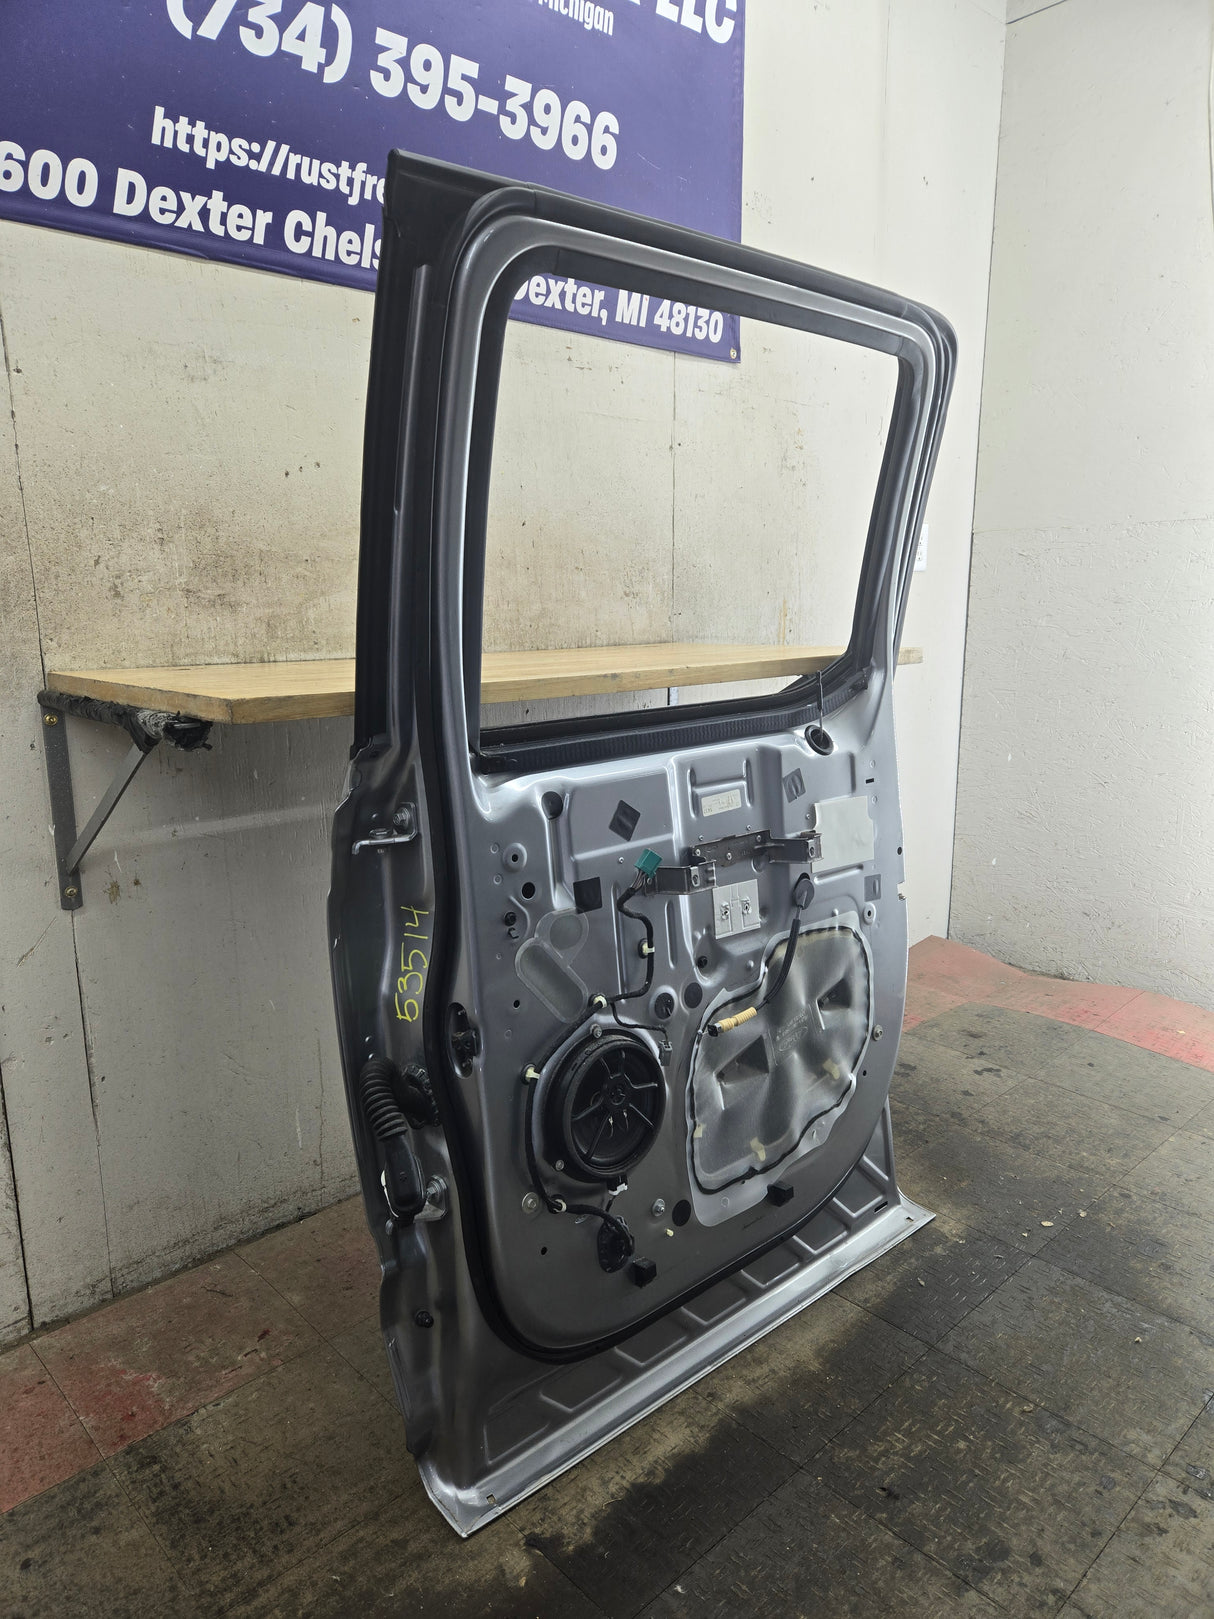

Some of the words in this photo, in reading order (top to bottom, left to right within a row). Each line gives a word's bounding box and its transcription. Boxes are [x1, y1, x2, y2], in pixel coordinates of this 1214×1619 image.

[538, 0, 614, 36] chigan
[370, 27, 619, 169] 395-3966
[0, 141, 98, 207] 600
[113, 167, 272, 245] Dexter
[615, 289, 649, 327] MI
[653, 299, 723, 343] 48130
[395, 905, 429, 1022] 53514
